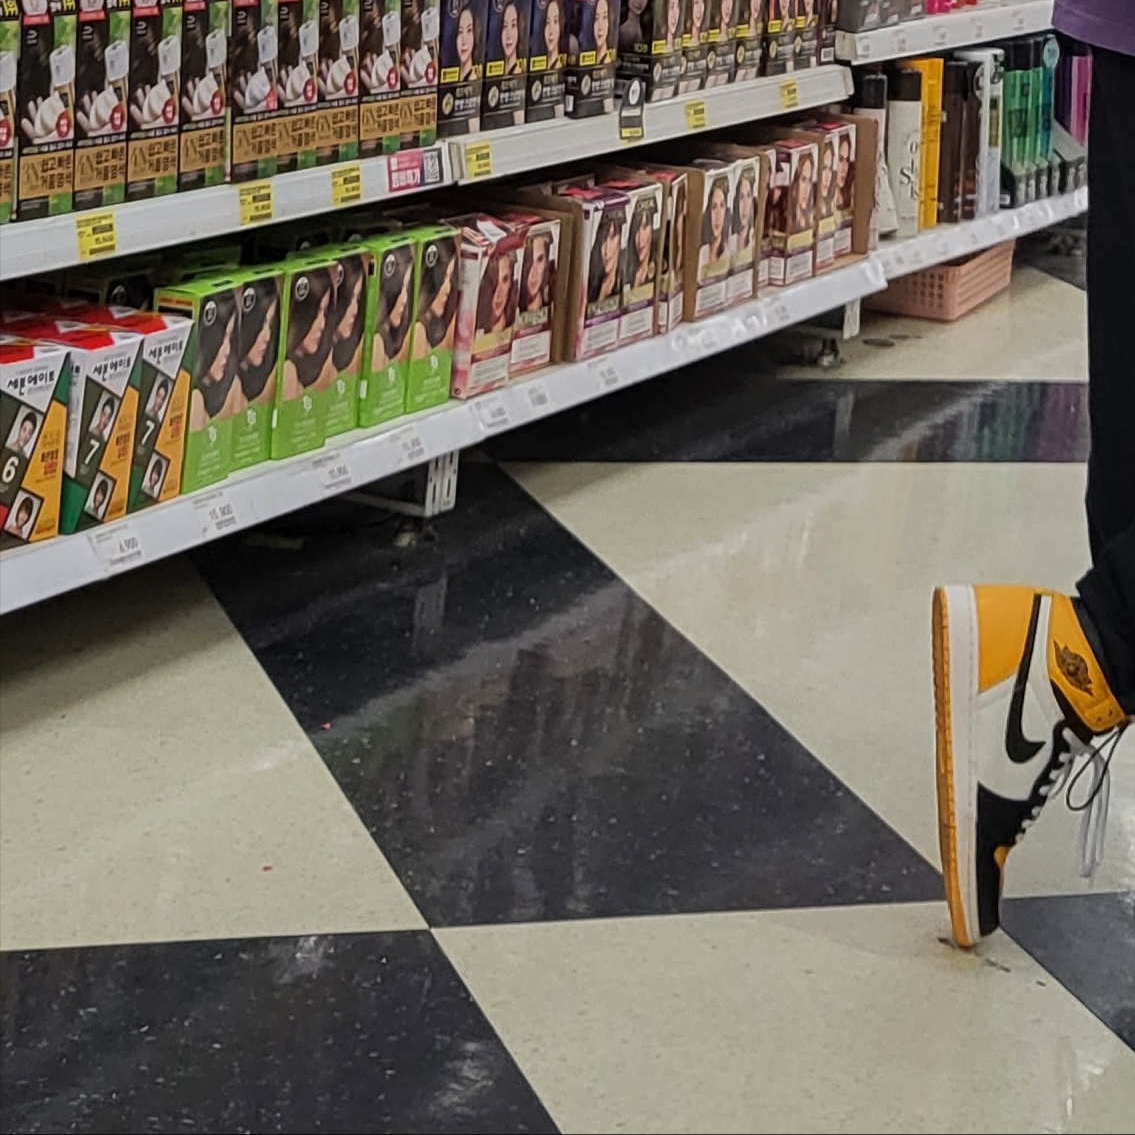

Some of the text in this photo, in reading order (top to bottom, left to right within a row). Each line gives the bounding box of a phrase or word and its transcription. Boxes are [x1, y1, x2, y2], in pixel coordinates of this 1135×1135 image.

[149, 340, 183, 364] 세븐에이트
[93, 359, 131, 382] 세븐에이트
[7, 371, 55, 397] 세븐에이트
[141, 420, 155, 445] 7
[85, 439, 100, 465] 7
[2, 456, 19, 483] 6
